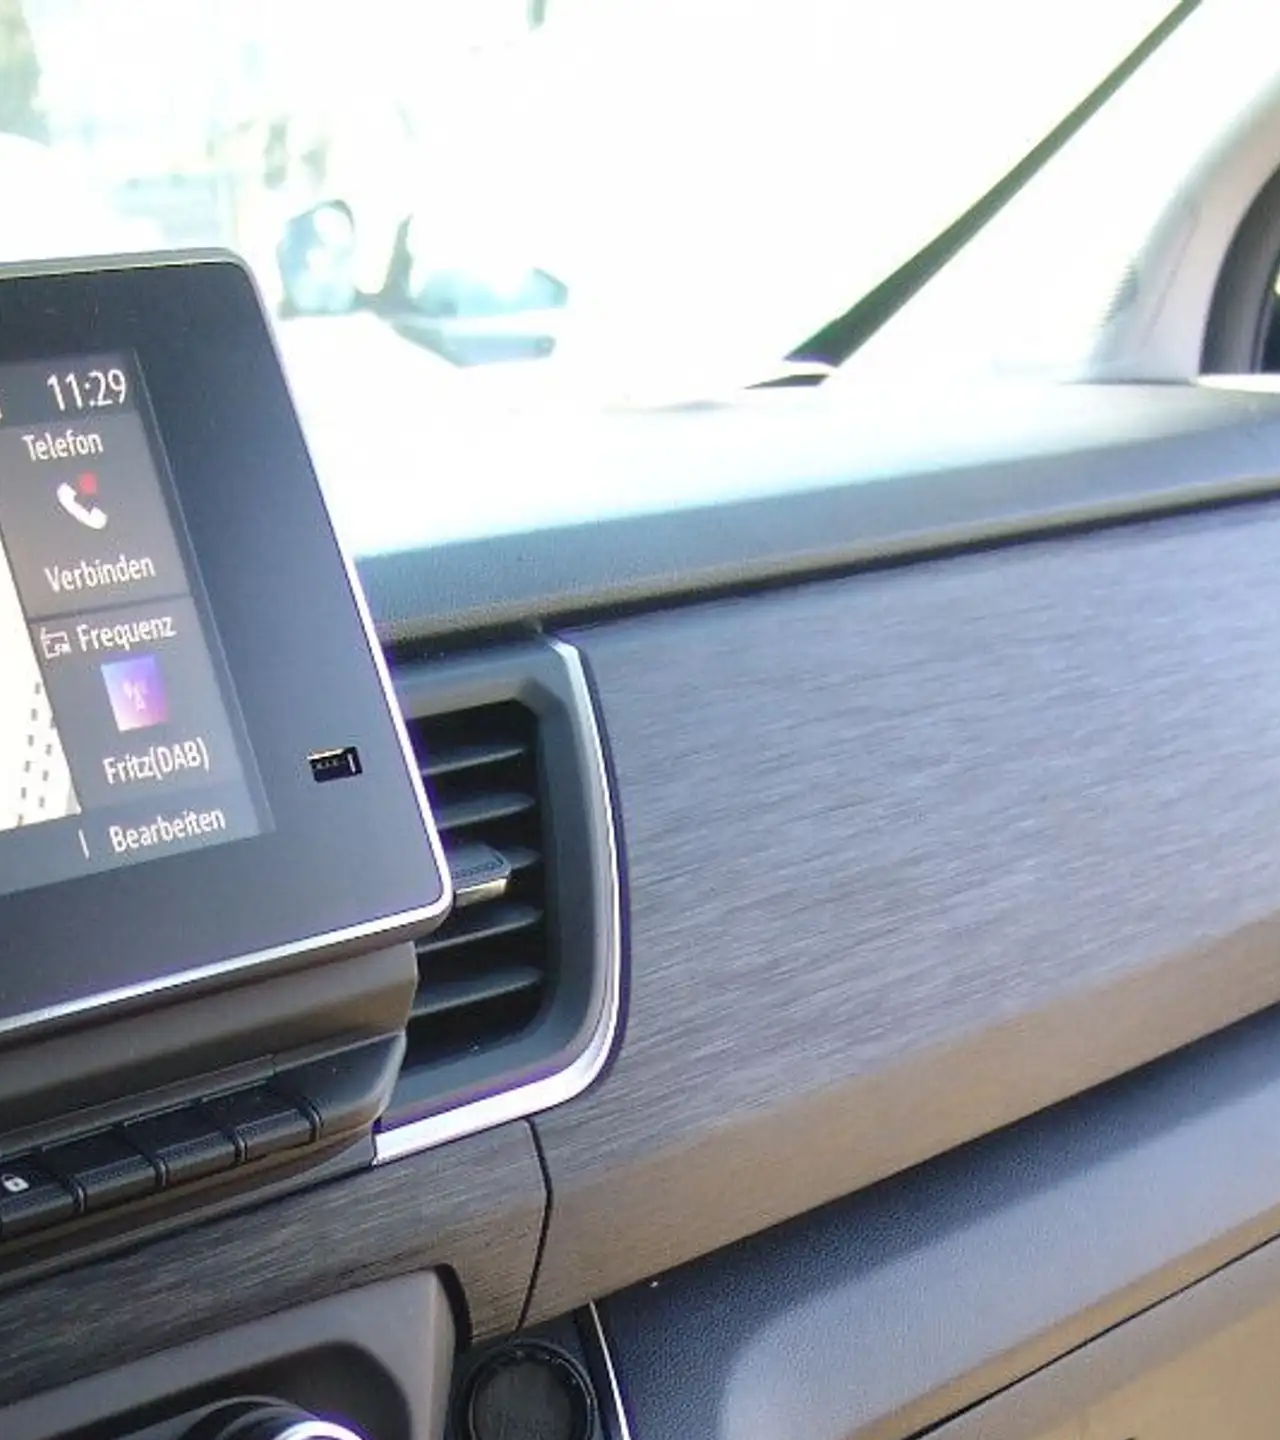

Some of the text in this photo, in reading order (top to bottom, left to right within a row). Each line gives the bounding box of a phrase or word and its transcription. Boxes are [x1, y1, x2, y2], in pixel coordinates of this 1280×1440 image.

[46, 368, 128, 413] 11:29
[21, 430, 104, 462] Telefon
[44, 553, 156, 593] Verbinden
[76, 612, 177, 656] Frequenz
[103, 737, 211, 785] Fritz(DAB)
[109, 807, 227, 855] Bearbeiten
